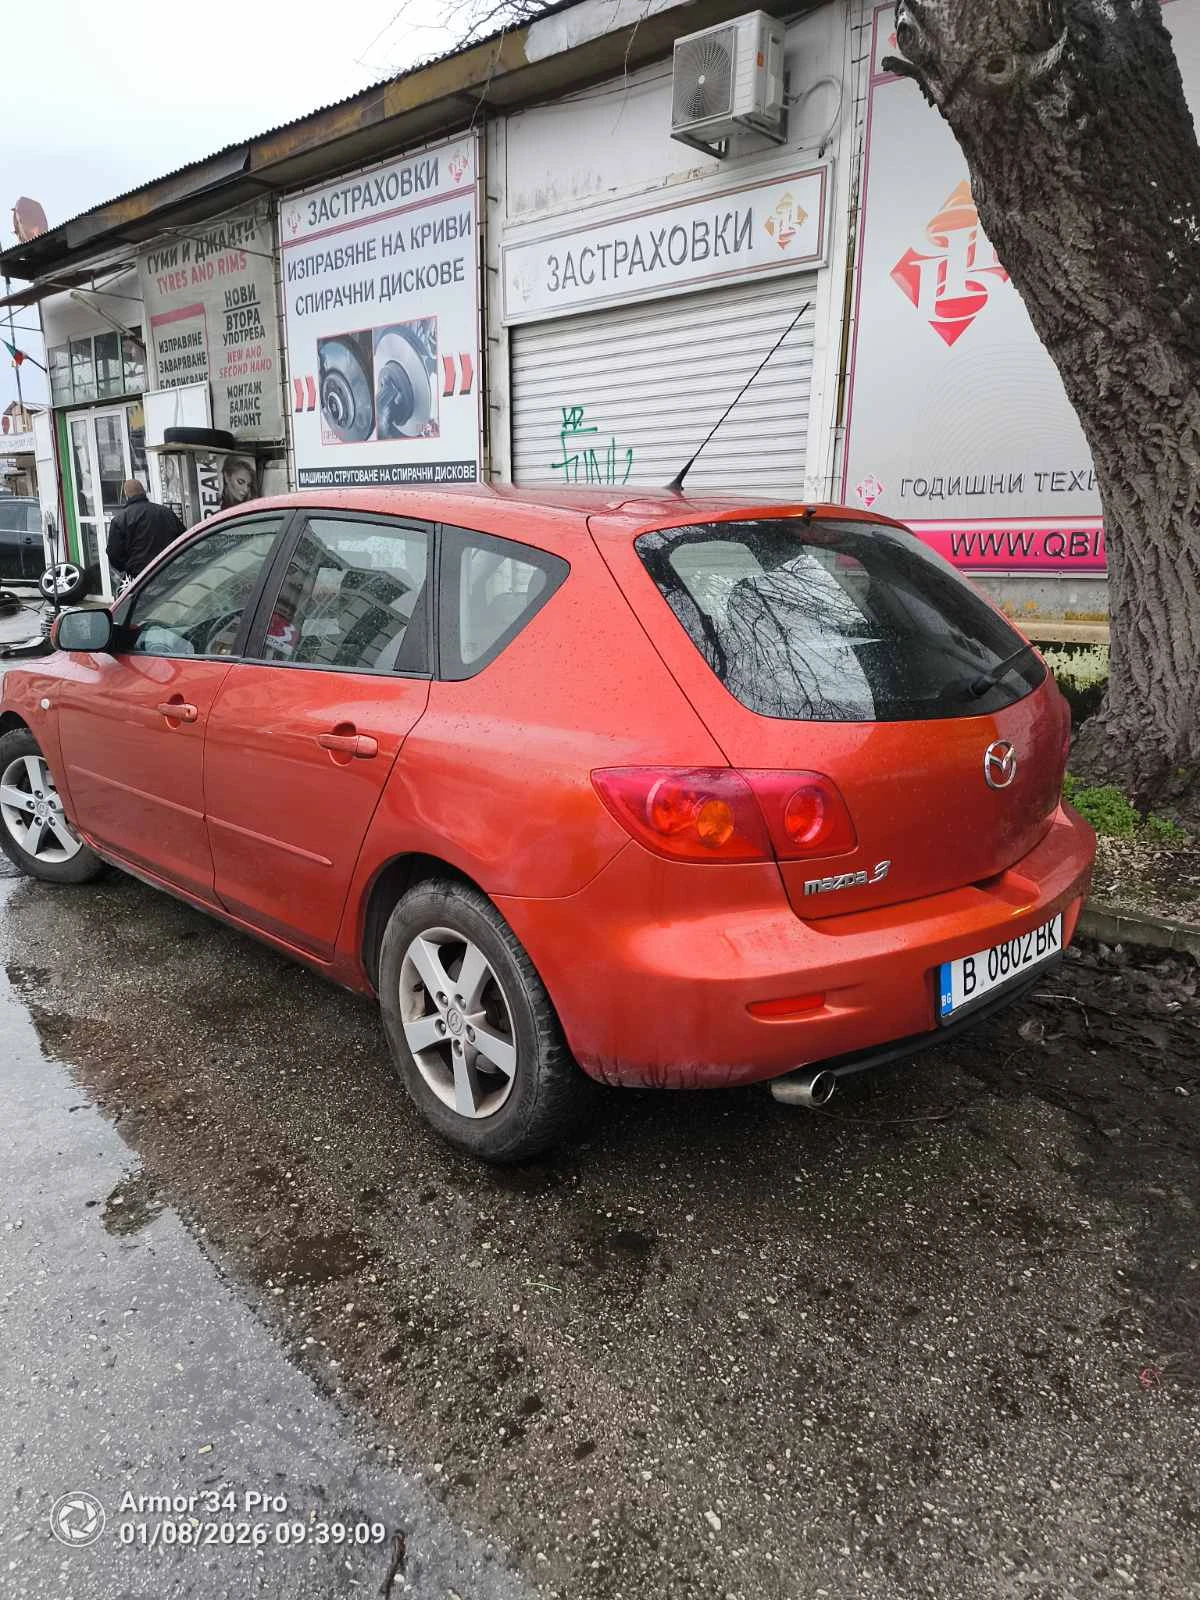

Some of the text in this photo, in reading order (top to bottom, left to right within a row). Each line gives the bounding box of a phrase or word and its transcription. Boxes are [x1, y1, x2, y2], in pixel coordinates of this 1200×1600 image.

[308, 157, 439, 226] ЗАСТРАХОВКИ
[147, 245, 178, 275] ГУМИ
[182, 241, 191, 264] И
[288, 211, 471, 282] ИЗПРАВЯНЕ НА КРИВИ
[547, 207, 753, 292] ЗАСТРАХОВКИ
[157, 251, 247, 297] TYRES AND RIMS
[296, 256, 464, 316] СПИРАЧНИ ДИСКОВЕ
[224, 283, 256, 308] НОВИ
[226, 308, 260, 332] ВТОРА
[159, 331, 203, 354] ИЗПРАВЯНЕ
[222, 325, 266, 347] УПОТРЕБА
[159, 351, 207, 374] ЗАВАРЯВАНЕ
[227, 349, 243, 364] NEW
[219, 364, 248, 379] SECOND
[227, 381, 262, 399] МОНТАЖ
[229, 397, 260, 414] БАЛАНС
[230, 413, 261, 428] РЕМОНТ
[300, 464, 476, 485] МАШИННО СТРУГОВАНЕ НА СПИРАЧНИ ДИСКОВЕ
[900, 472, 1024, 500] ГОДИШНИ
[951, 530, 1105, 559] WWW.QBI
[868, 859, 891, 884] 3
[941, 993, 952, 1007] BG
